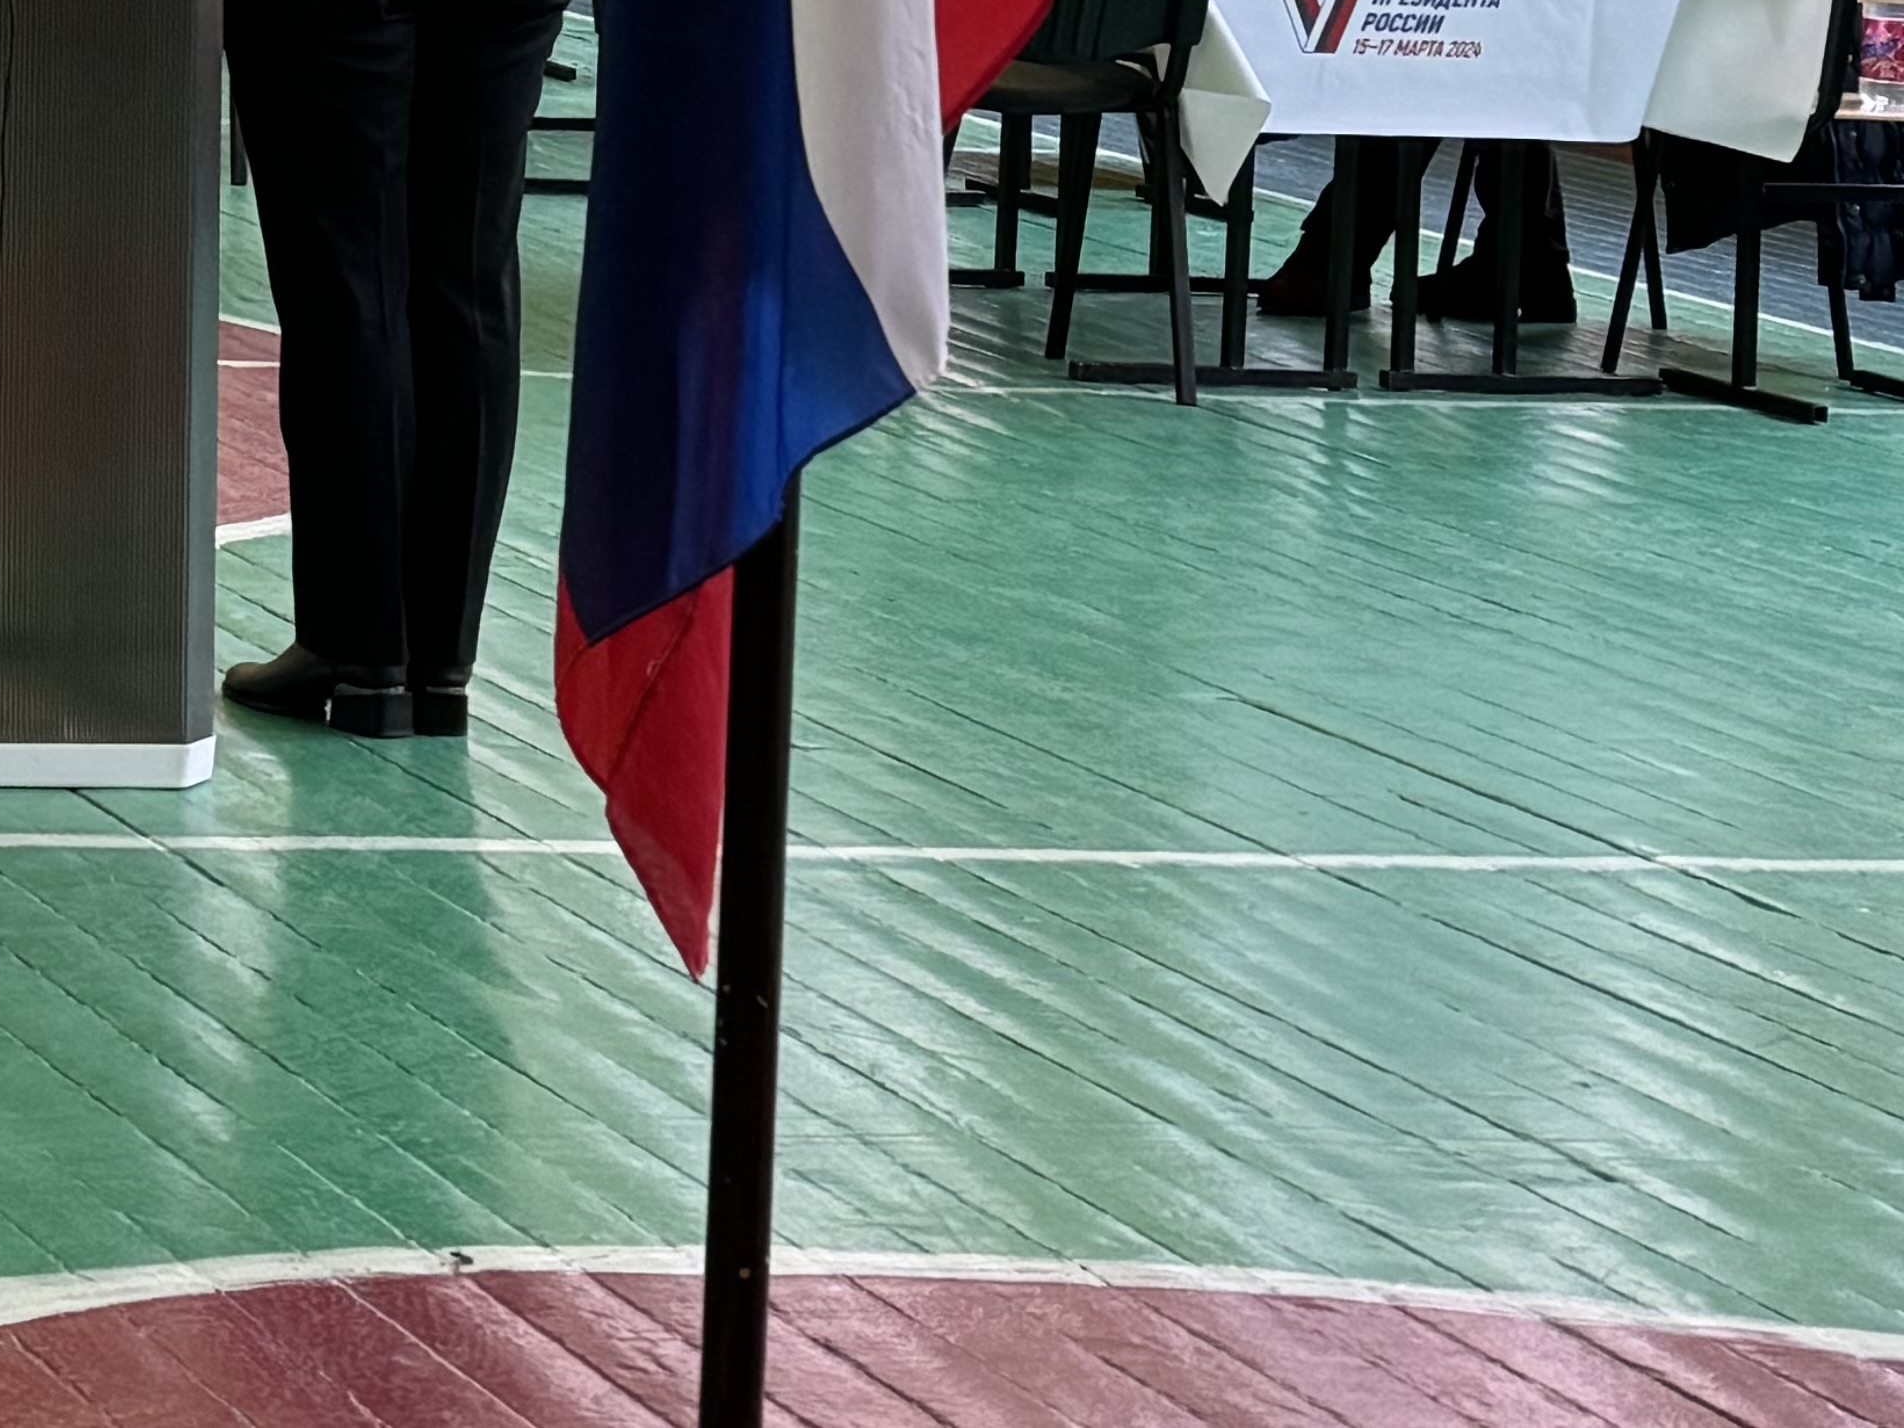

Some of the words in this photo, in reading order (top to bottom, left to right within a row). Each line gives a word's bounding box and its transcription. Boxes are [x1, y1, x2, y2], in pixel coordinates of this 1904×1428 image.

[1361, 12, 1446, 34] РОССИИ
[1394, 40, 1445, 57] МАРТА
[1446, 40, 1482, 59] 2024
